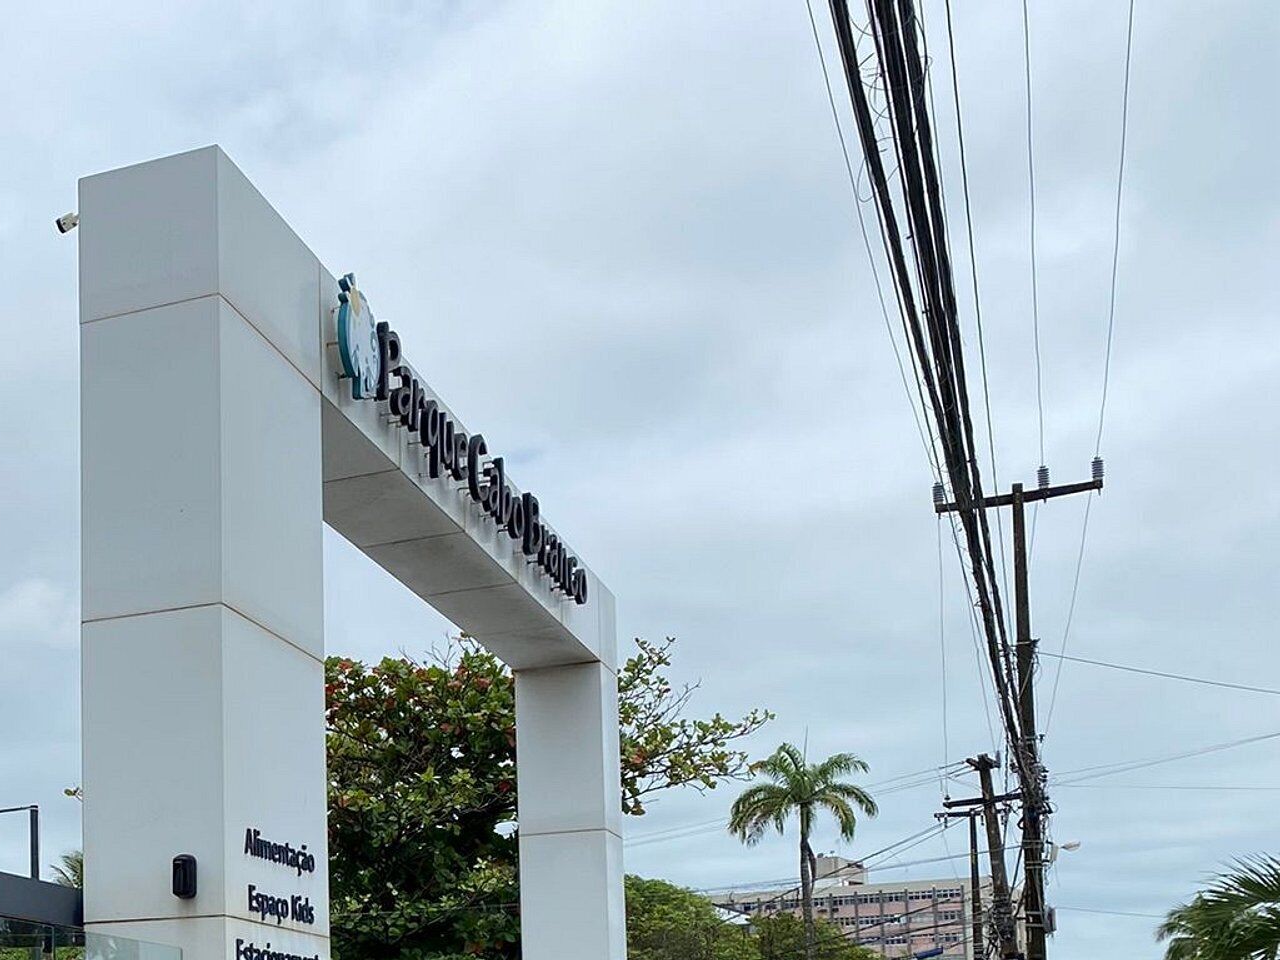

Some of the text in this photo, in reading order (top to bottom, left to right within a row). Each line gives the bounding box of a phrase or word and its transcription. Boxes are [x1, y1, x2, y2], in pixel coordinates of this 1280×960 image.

[376, 321, 588, 605] Parque Cabo Branco
[244, 828, 315, 876] Alimentação
[248, 884, 314, 925] Espaço Kids
